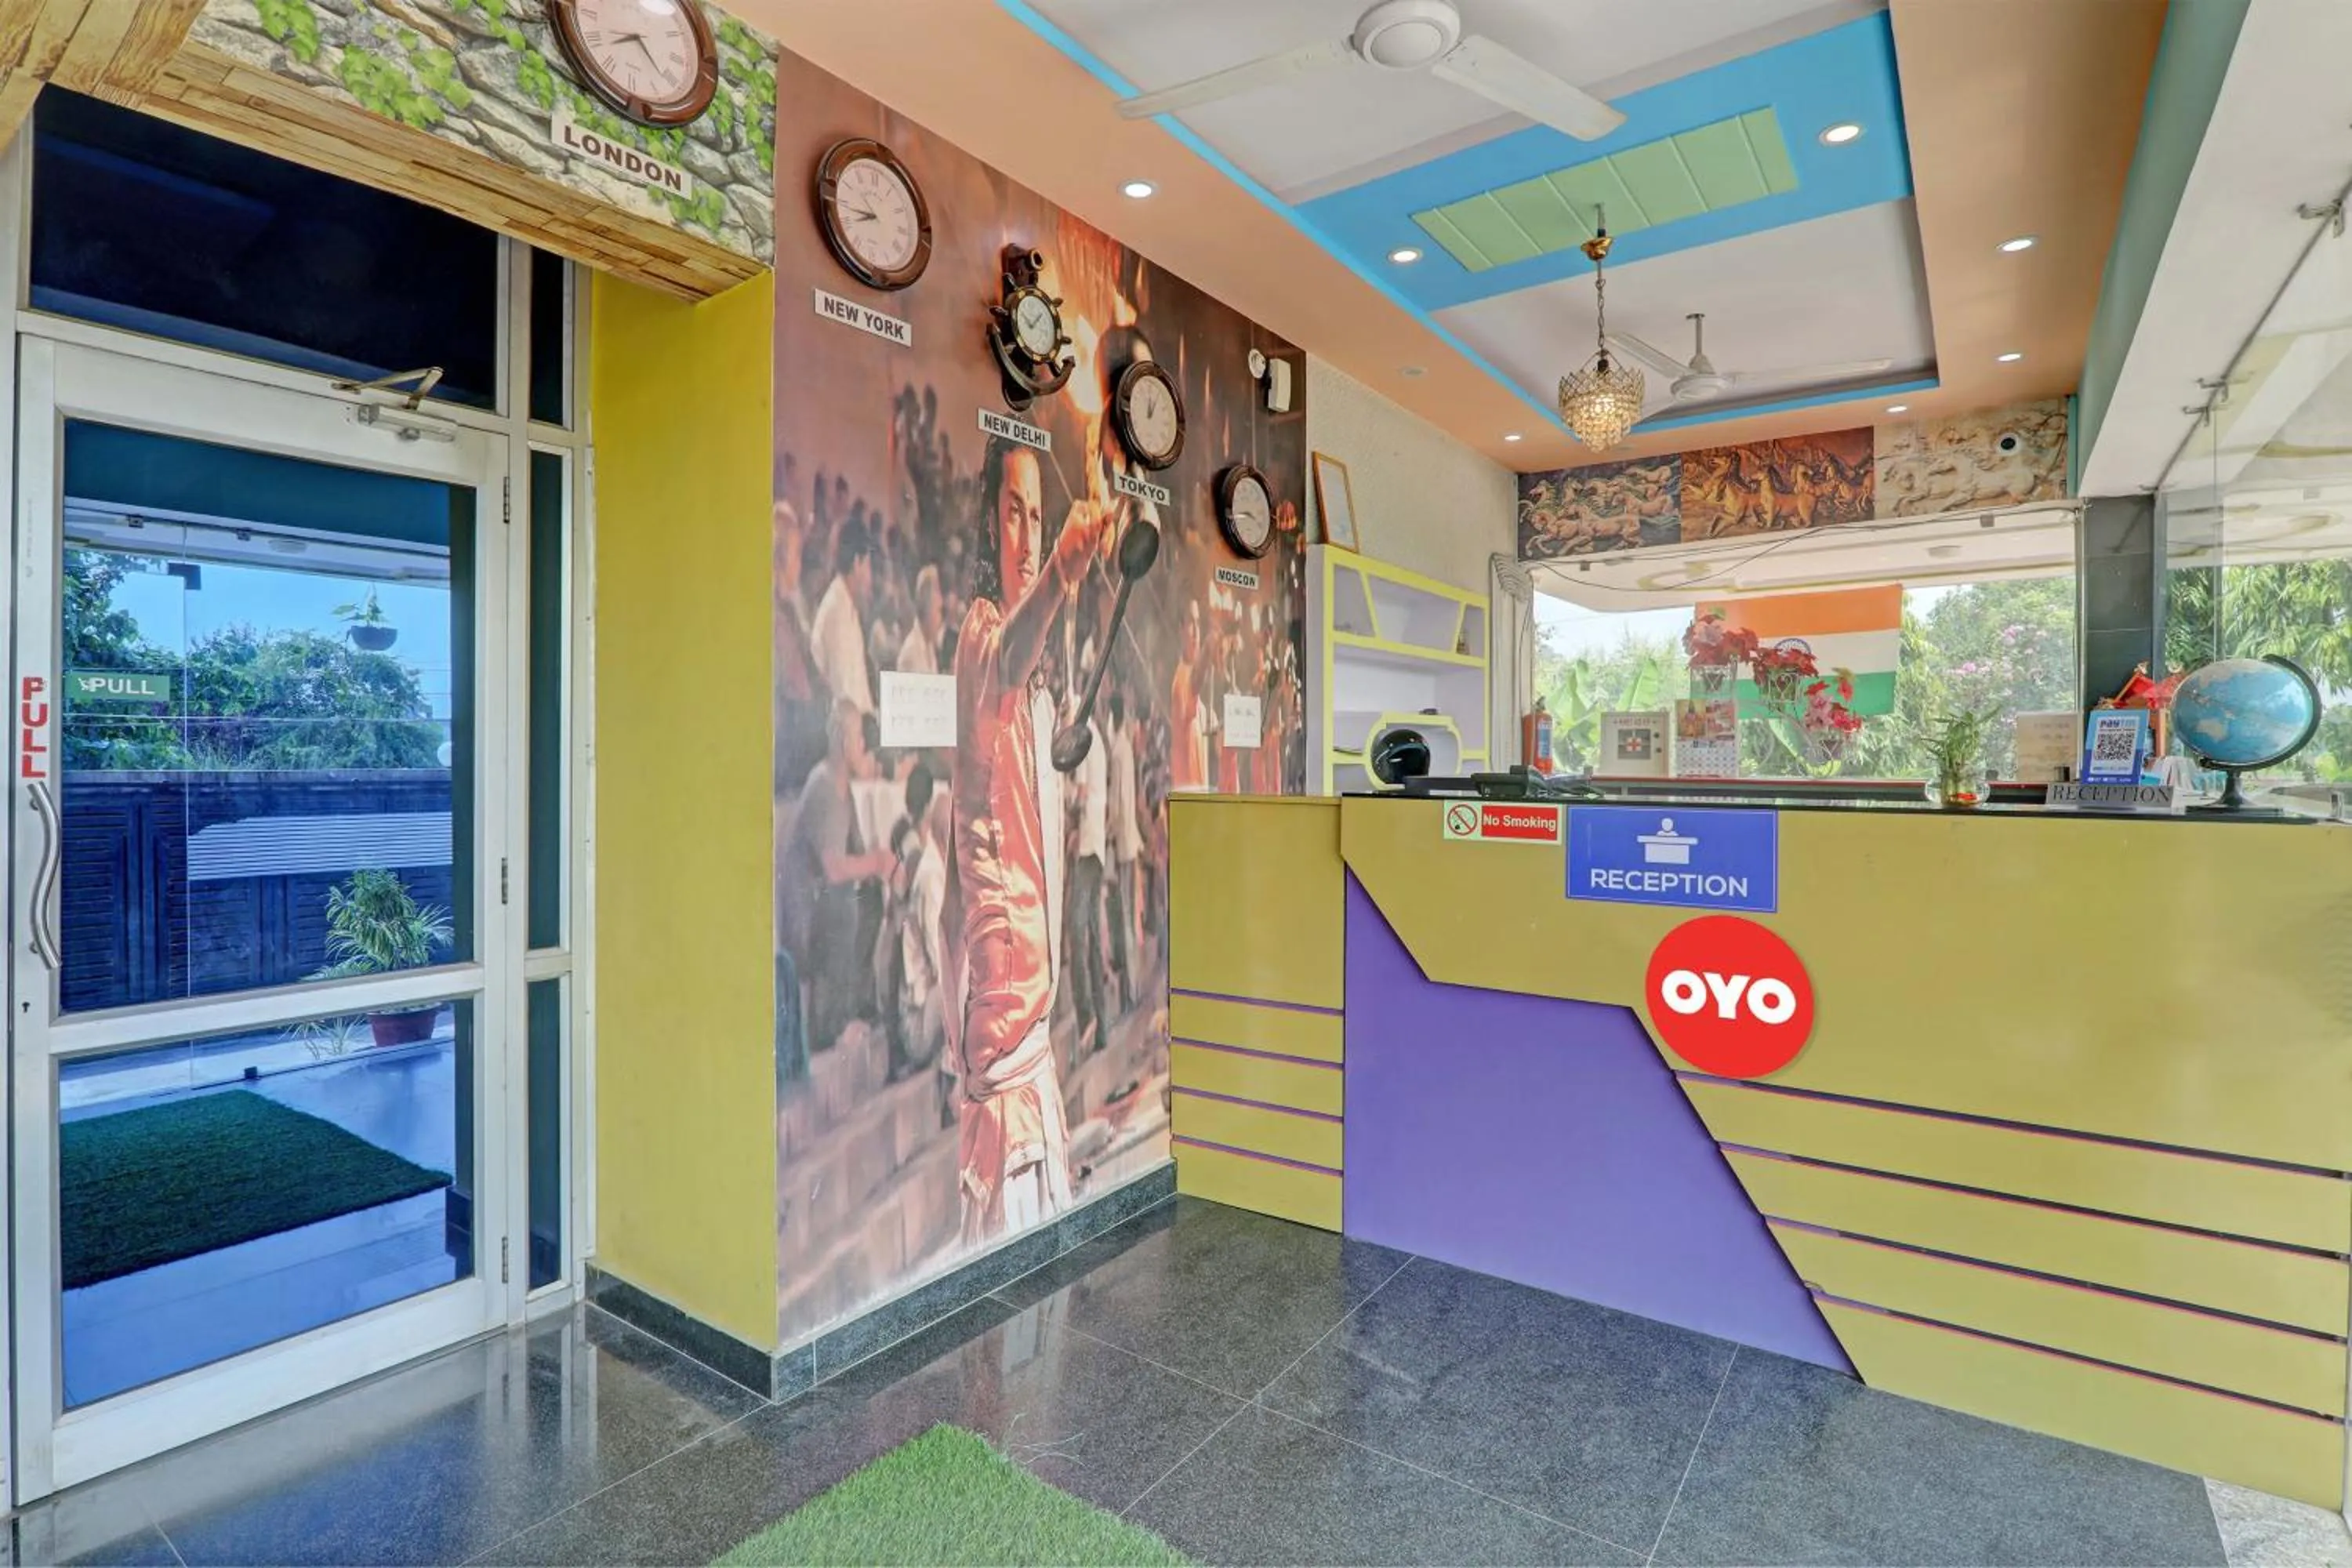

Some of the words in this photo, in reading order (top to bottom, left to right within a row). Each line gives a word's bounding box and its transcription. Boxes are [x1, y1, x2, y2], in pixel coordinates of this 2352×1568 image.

[564, 125, 682, 191] LONDON
[824, 296, 859, 322] NEW
[863, 310, 904, 340] YORK
[984, 413, 1011, 435] NEW
[1013, 422, 1046, 447] DELHI
[1119, 476, 1166, 501] TOKYO
[89, 677, 156, 695] PULL
[22, 677, 49, 779] PULL
[2053, 785, 2174, 802] RECEPTION
[1482, 812, 1501, 826] No
[1502, 815, 1557, 832] Smoking
[1590, 868, 1748, 898] RECEPTION
[1661, 969, 1797, 1025] OYO
